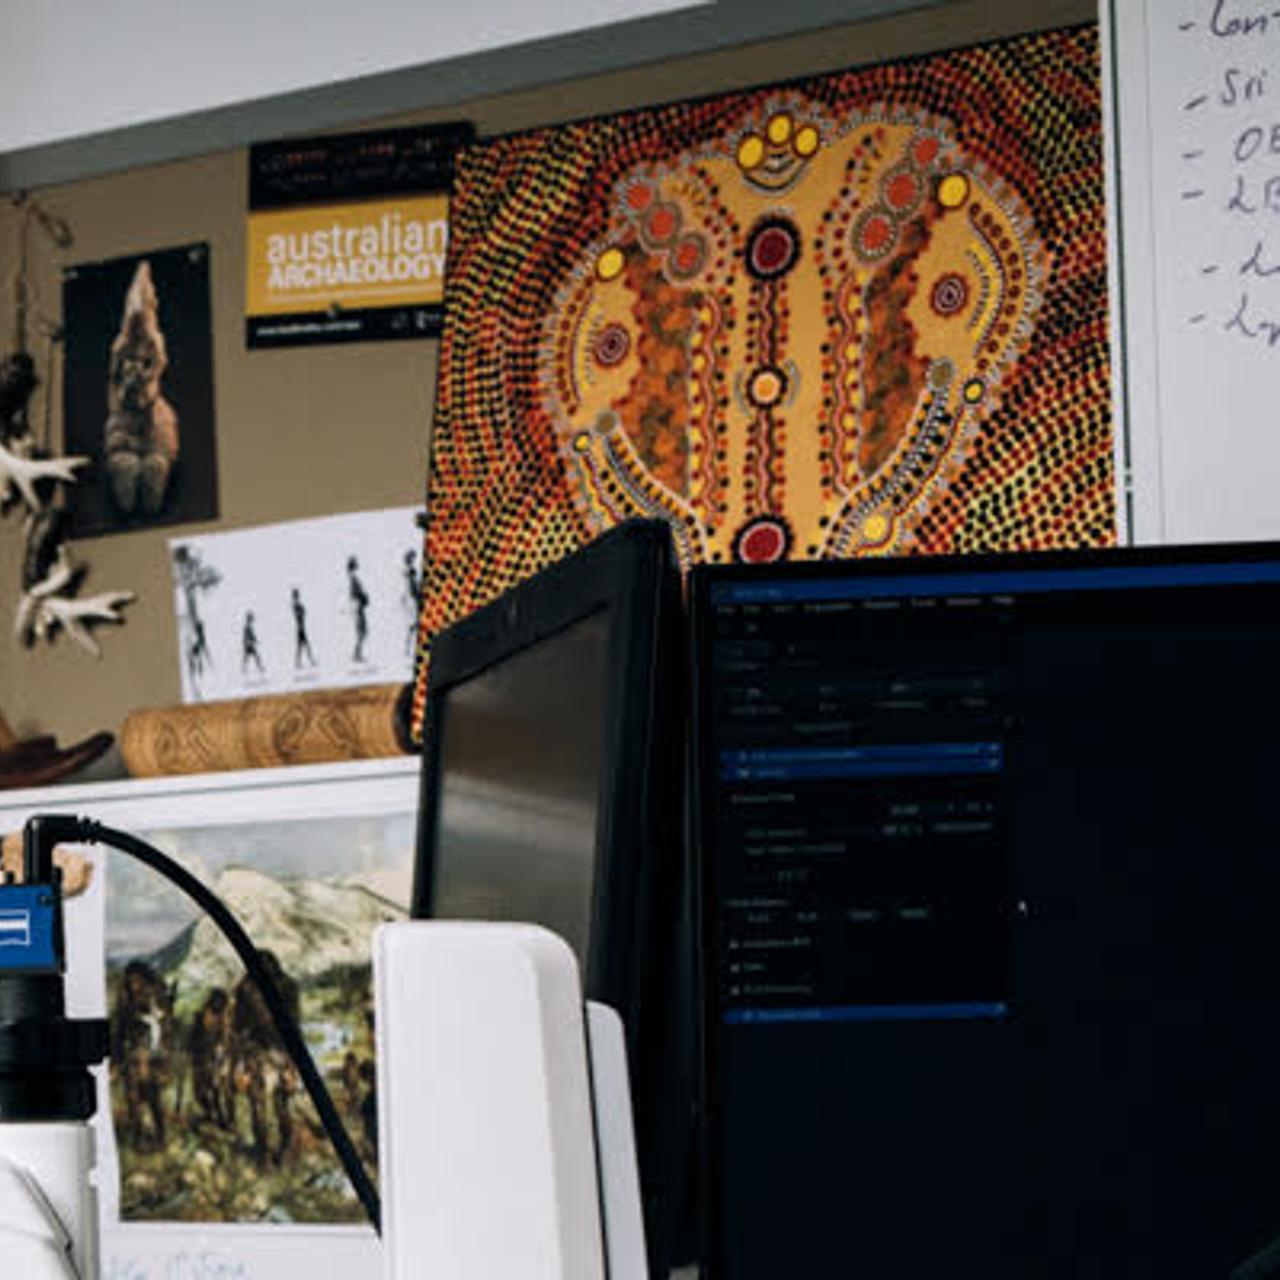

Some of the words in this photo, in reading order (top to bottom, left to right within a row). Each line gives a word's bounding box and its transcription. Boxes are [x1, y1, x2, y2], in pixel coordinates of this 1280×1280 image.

[1220, 68, 1268, 105] Sri
[267, 213, 449, 264] australian
[267, 254, 446, 289] ARCHAEOLOGY
